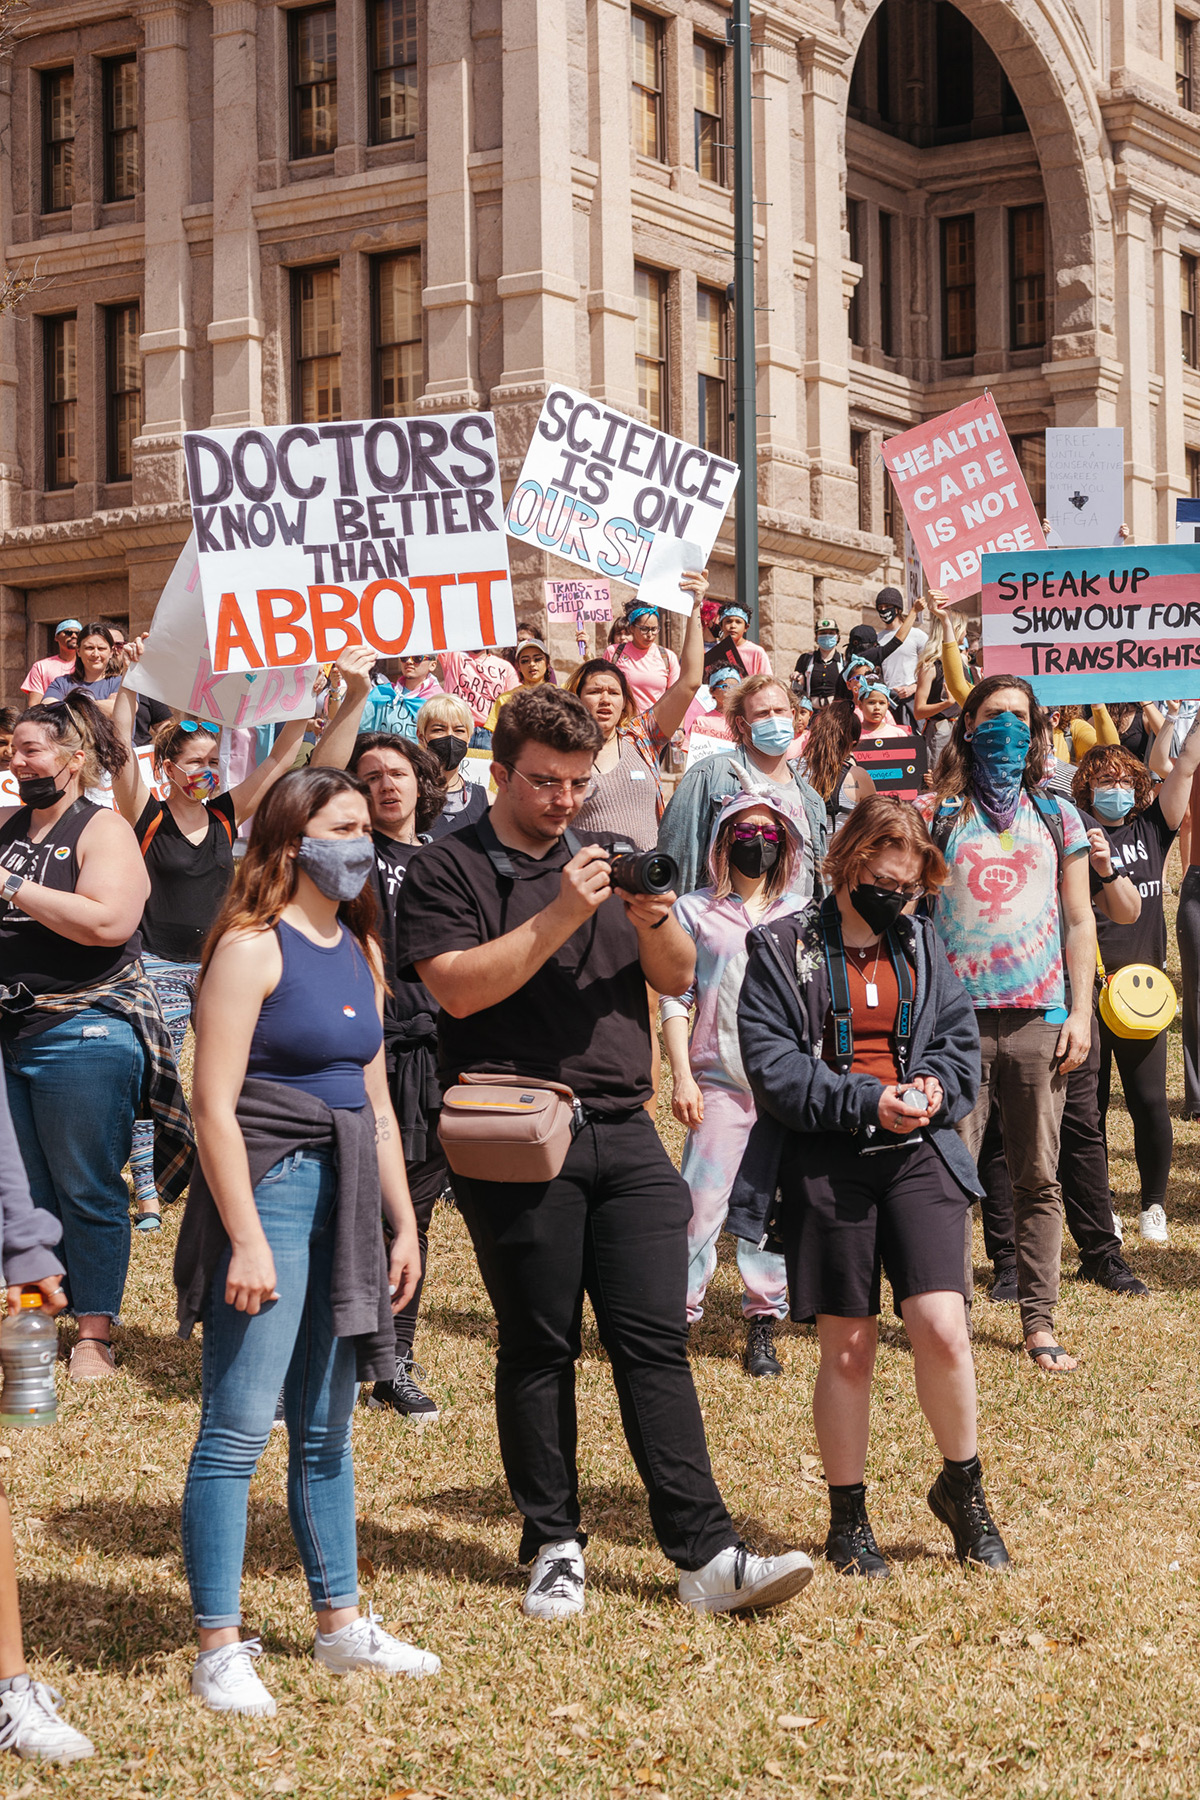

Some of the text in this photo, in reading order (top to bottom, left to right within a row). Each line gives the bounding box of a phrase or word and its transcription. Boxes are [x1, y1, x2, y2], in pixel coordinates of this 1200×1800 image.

[184, 416, 496, 507] DOCTORS
[538, 390, 736, 510] SCIENCE
[892, 412, 1000, 482] HEALTH
[1051, 450, 1095, 459] UNTIL A
[913, 449, 1008, 512] CARE
[1049, 460, 1122, 470] CONSERVATIVE
[1050, 471, 1098, 480] DISAGREES
[551, 448, 694, 538] IS ON
[193, 489, 499, 553] KNOW BETTER
[508, 479, 655, 586] OUR SI
[924, 482, 1019, 549] IS NOT
[1049, 511, 1099, 527] #FGA
[303, 538, 409, 584] THAN
[594, 589, 609, 601] IS
[997, 567, 1150, 601] SPEAK UP
[213, 570, 507, 672] ABBOTT
[547, 600, 584, 613] CHILD
[458, 673, 502, 699] GREG
[694, 726, 709, 734] Our
[1134, 881, 1160, 898] OTT
[901, 1002, 910, 1035] MINOLTA
[839, 1020, 849, 1054] MINOLTA
